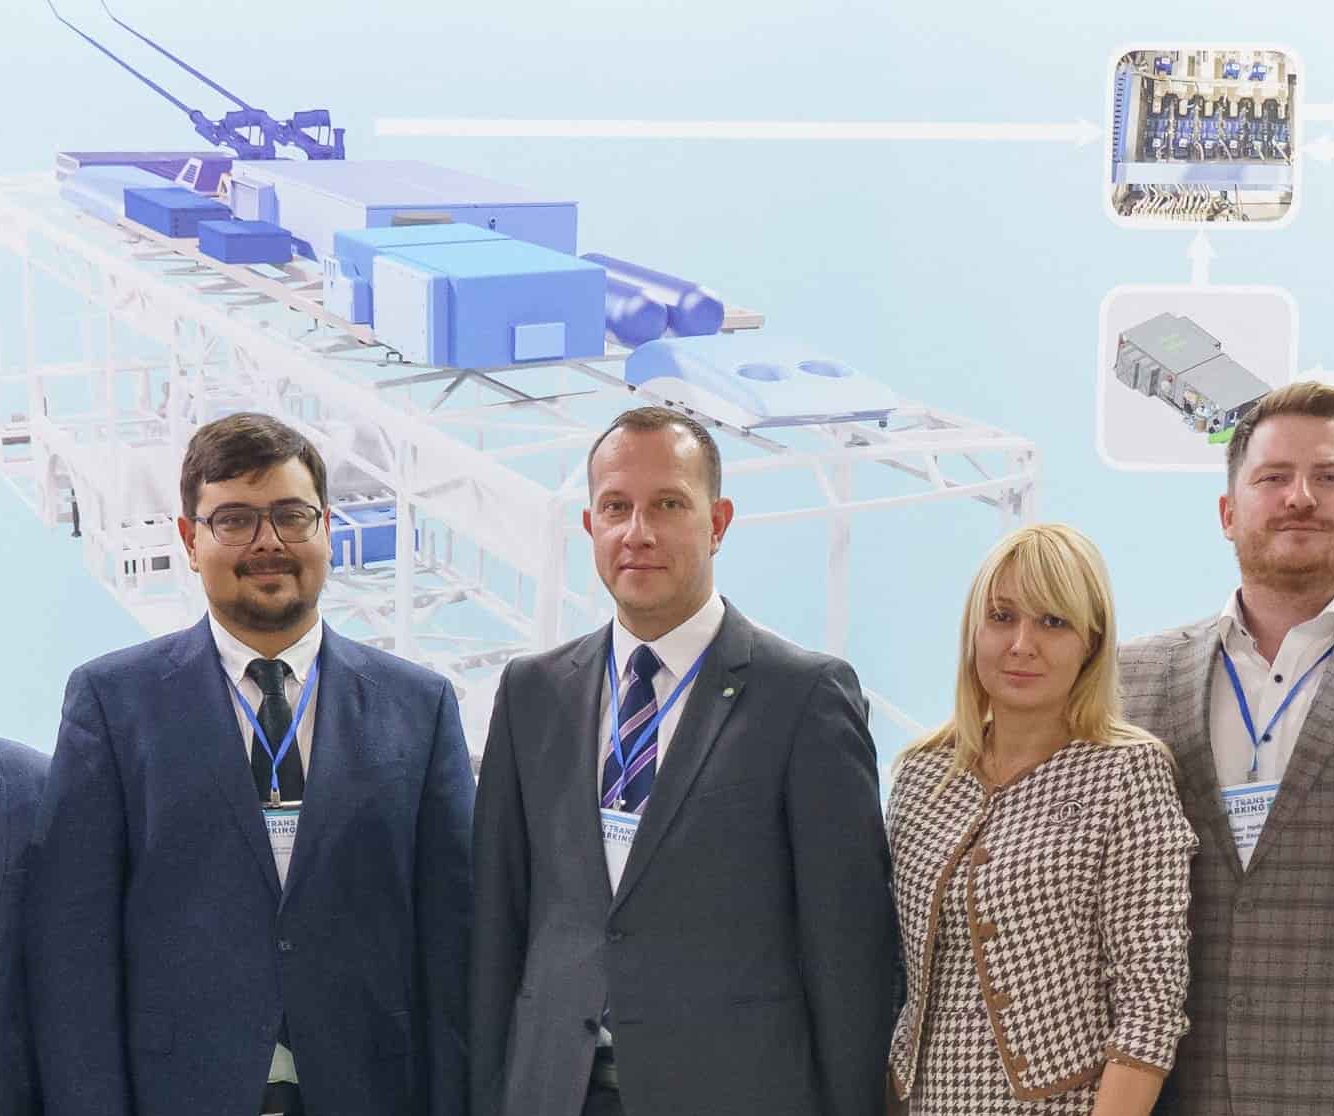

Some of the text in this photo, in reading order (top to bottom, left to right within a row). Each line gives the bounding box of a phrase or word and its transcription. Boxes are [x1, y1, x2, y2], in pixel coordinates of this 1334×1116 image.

[1235, 797, 1265, 806] TRANS
[1228, 804, 1265, 815] ARKING
[267, 819, 296, 827] TRANS
